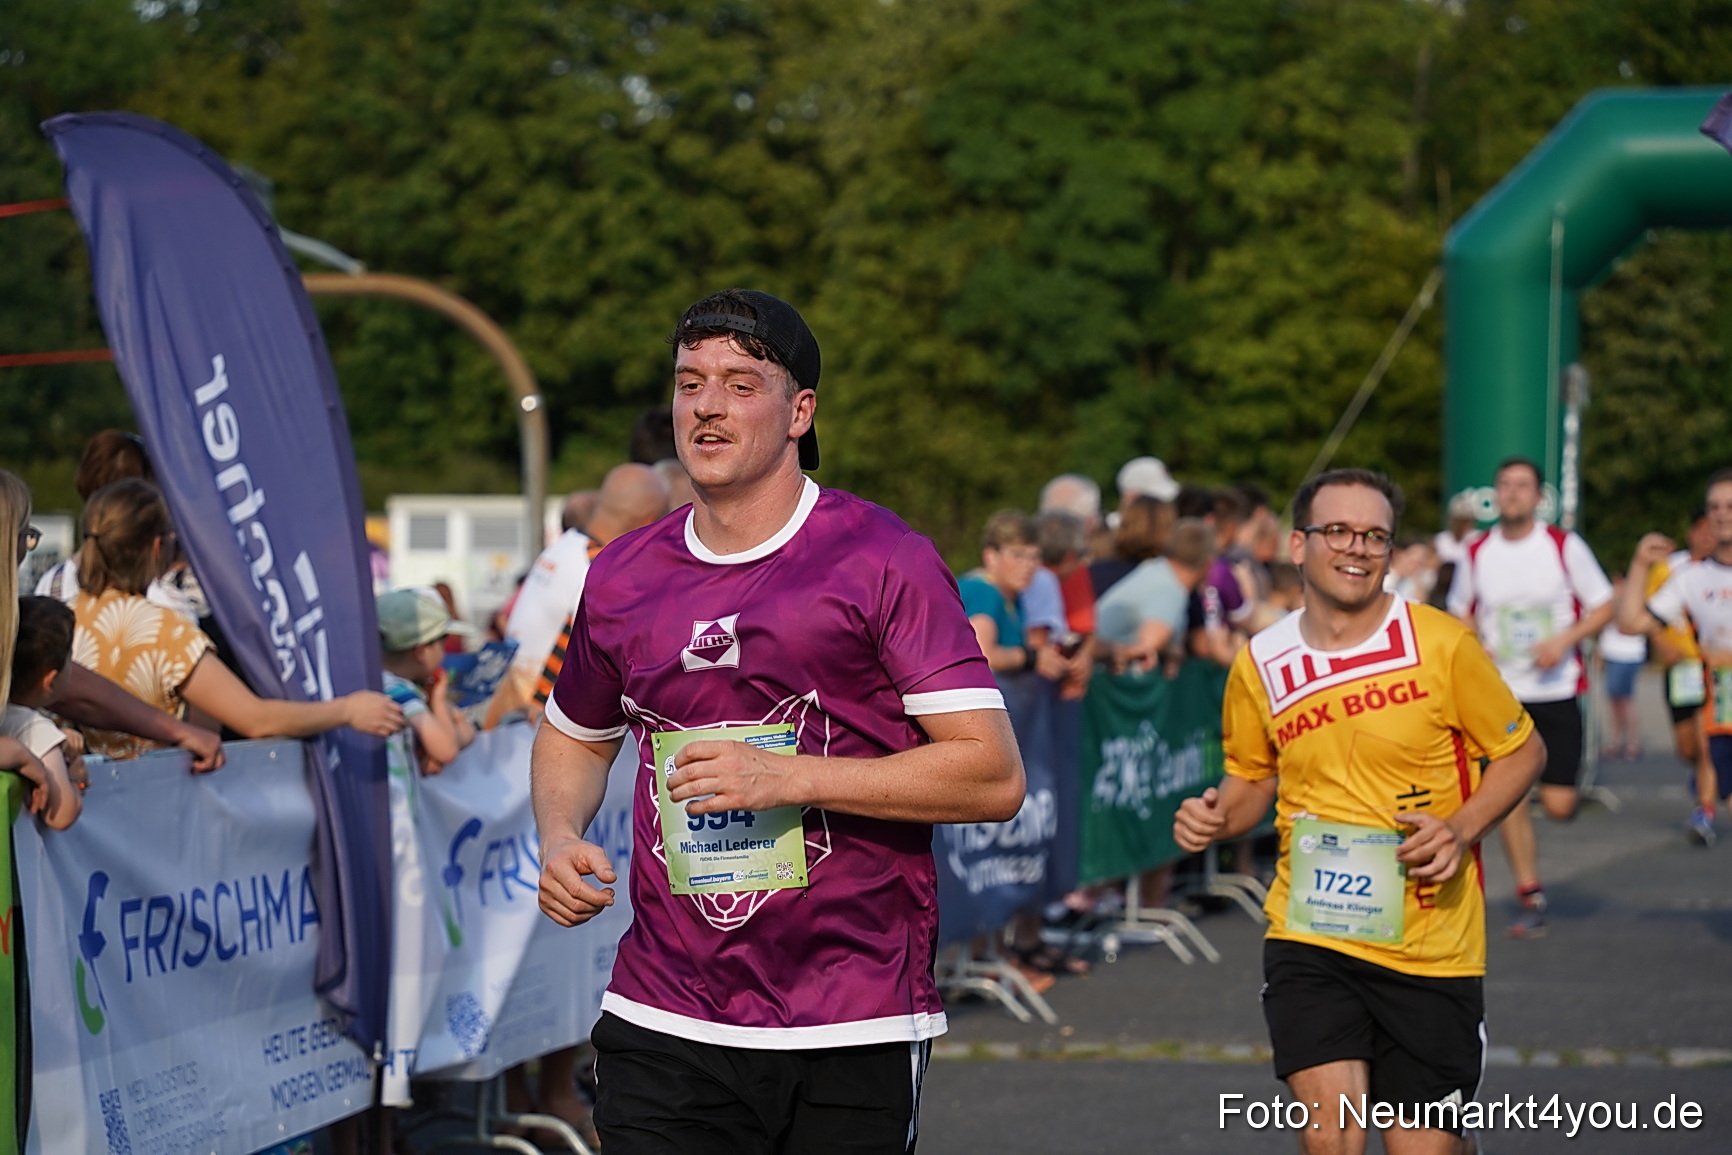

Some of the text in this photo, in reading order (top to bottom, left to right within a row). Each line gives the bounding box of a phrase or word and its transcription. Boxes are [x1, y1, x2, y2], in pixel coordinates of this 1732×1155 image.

[688, 634, 735, 649] UCHS
[1276, 680, 1429, 747] MAX BÖGL
[680, 837, 776, 854] Michael Lederer
[1313, 867, 1372, 897] 1722
[261, 1025, 307, 1067] HEUTE
[270, 1070, 325, 1113] MORGEN
